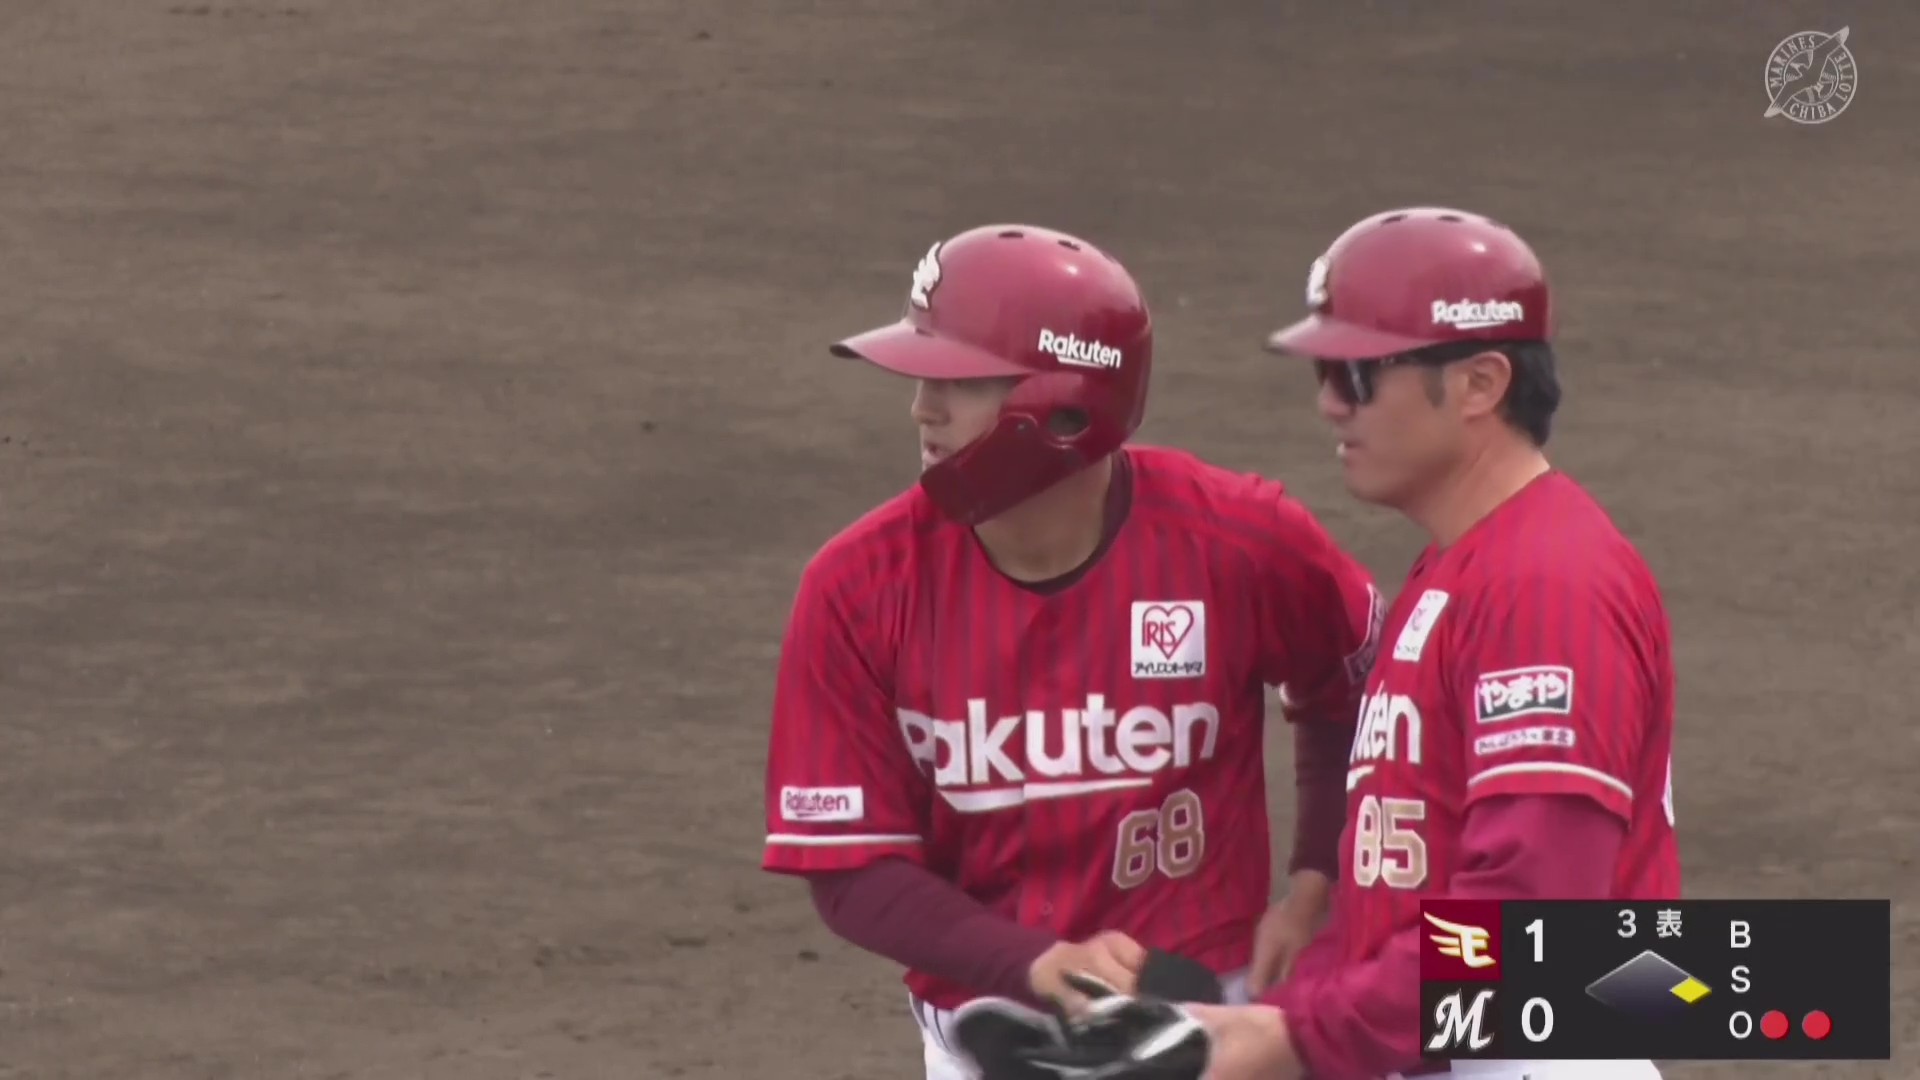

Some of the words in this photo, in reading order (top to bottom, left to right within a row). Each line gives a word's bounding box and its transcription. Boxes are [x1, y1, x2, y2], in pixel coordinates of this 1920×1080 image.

[1431, 298, 1523, 330] Rakuten
[1038, 328, 1121, 369] Rakuten
[1479, 673, 1566, 713] やまや
[897, 694, 1219, 795] Rakuten
[785, 790, 850, 817] Rakuten
[1112, 788, 1205, 889] 68
[1353, 794, 1428, 889] 85
